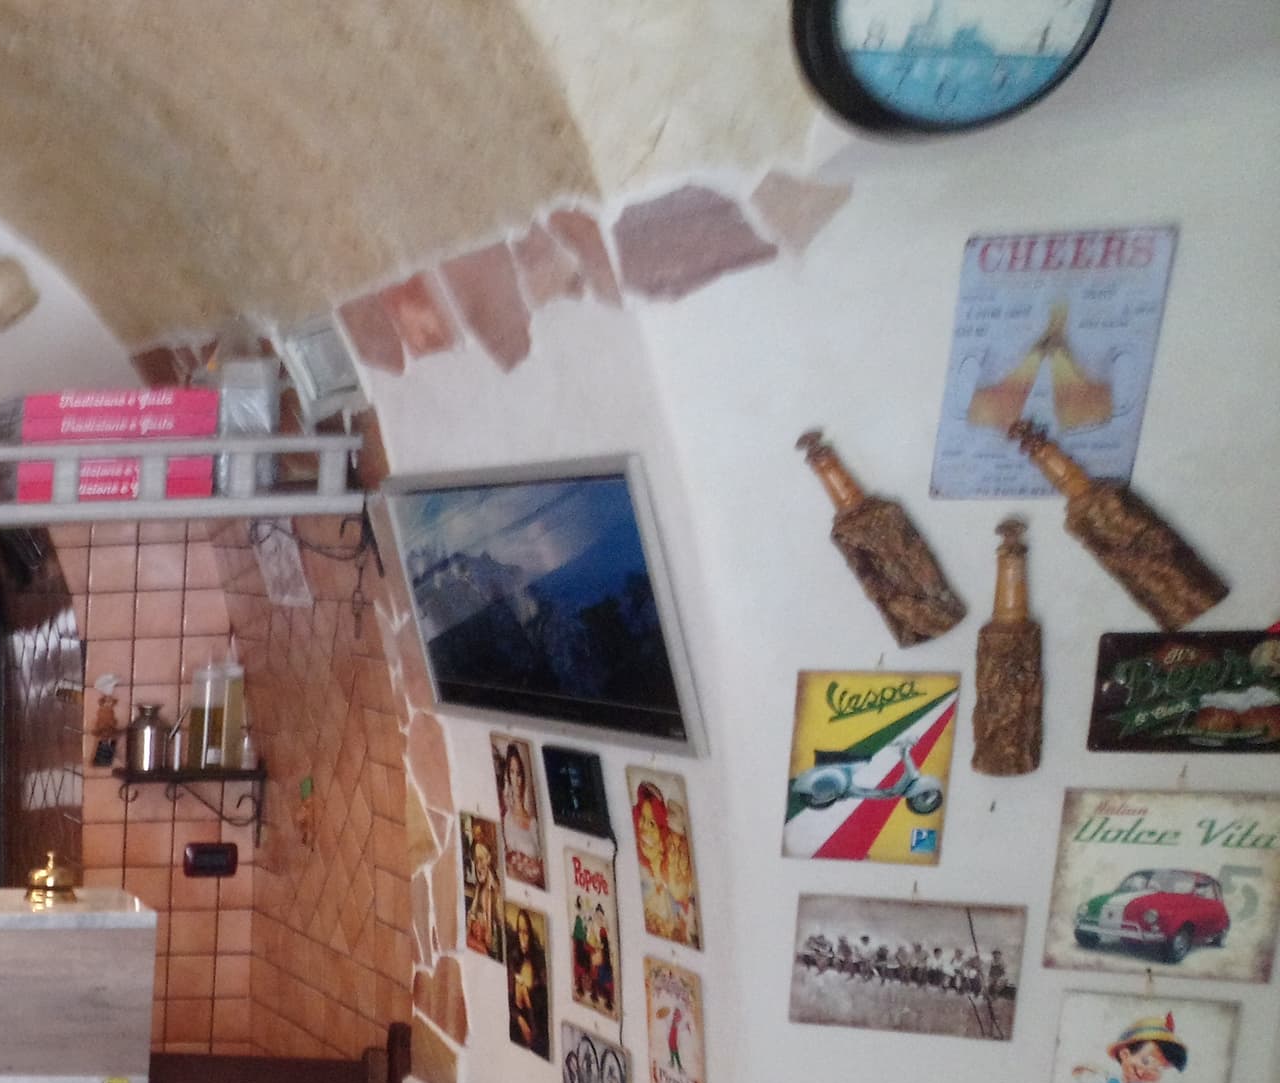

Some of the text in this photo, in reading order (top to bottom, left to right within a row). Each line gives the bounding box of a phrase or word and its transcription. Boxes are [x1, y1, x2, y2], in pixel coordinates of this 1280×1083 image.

[979, 234, 1155, 273] CHEERS
[825, 681, 928, 723] Vespa
[1073, 816, 1280, 849] Dolce Vita
